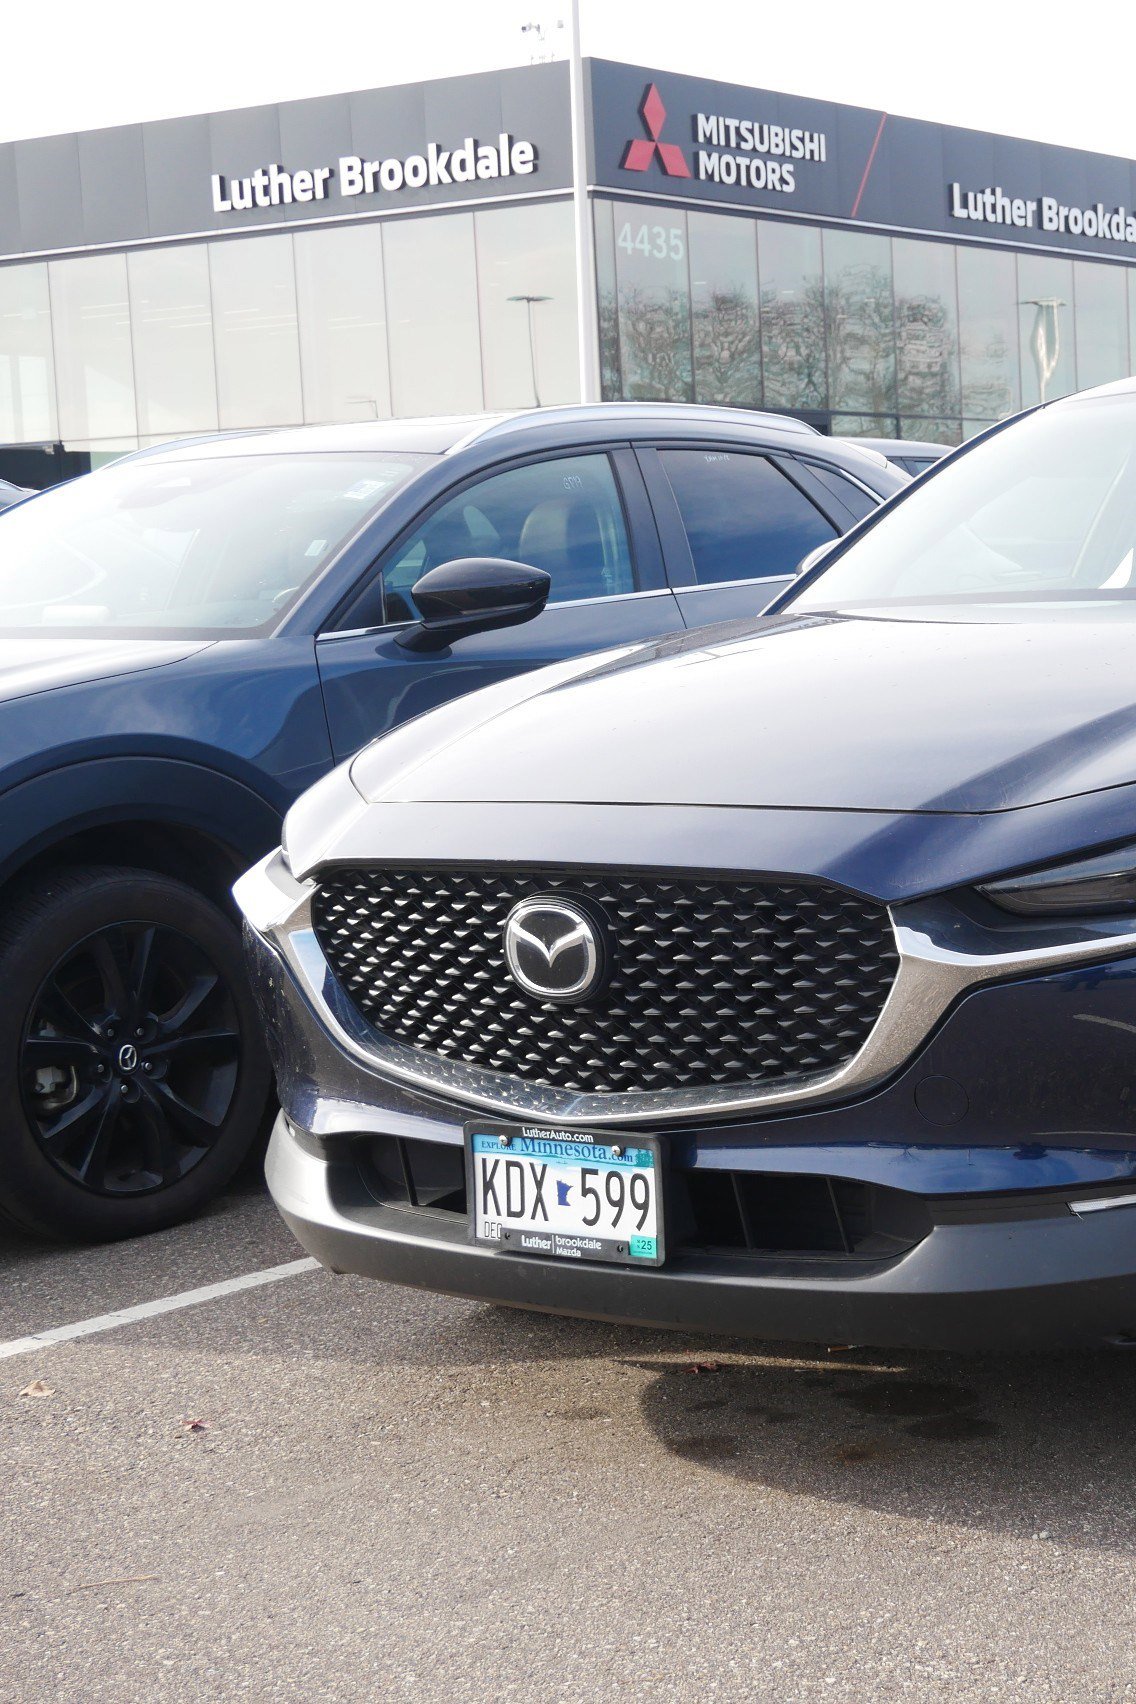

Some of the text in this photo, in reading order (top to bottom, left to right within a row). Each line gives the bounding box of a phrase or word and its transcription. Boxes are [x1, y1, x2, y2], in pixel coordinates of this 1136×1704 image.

[696, 112, 827, 163] MITSUBISHI
[211, 132, 536, 213] Luther Brookdale
[698, 150, 796, 194] MOTORS
[951, 182, 1038, 228] Luther
[617, 222, 685, 261] 4435
[522, 1126, 594, 1143] LutherAuto.com
[481, 1157, 651, 1232] KDX 599
[521, 1234, 602, 1250] Luther brookdale
[556, 1246, 582, 1257] Mazda
[641, 1240, 653, 1251] 25
